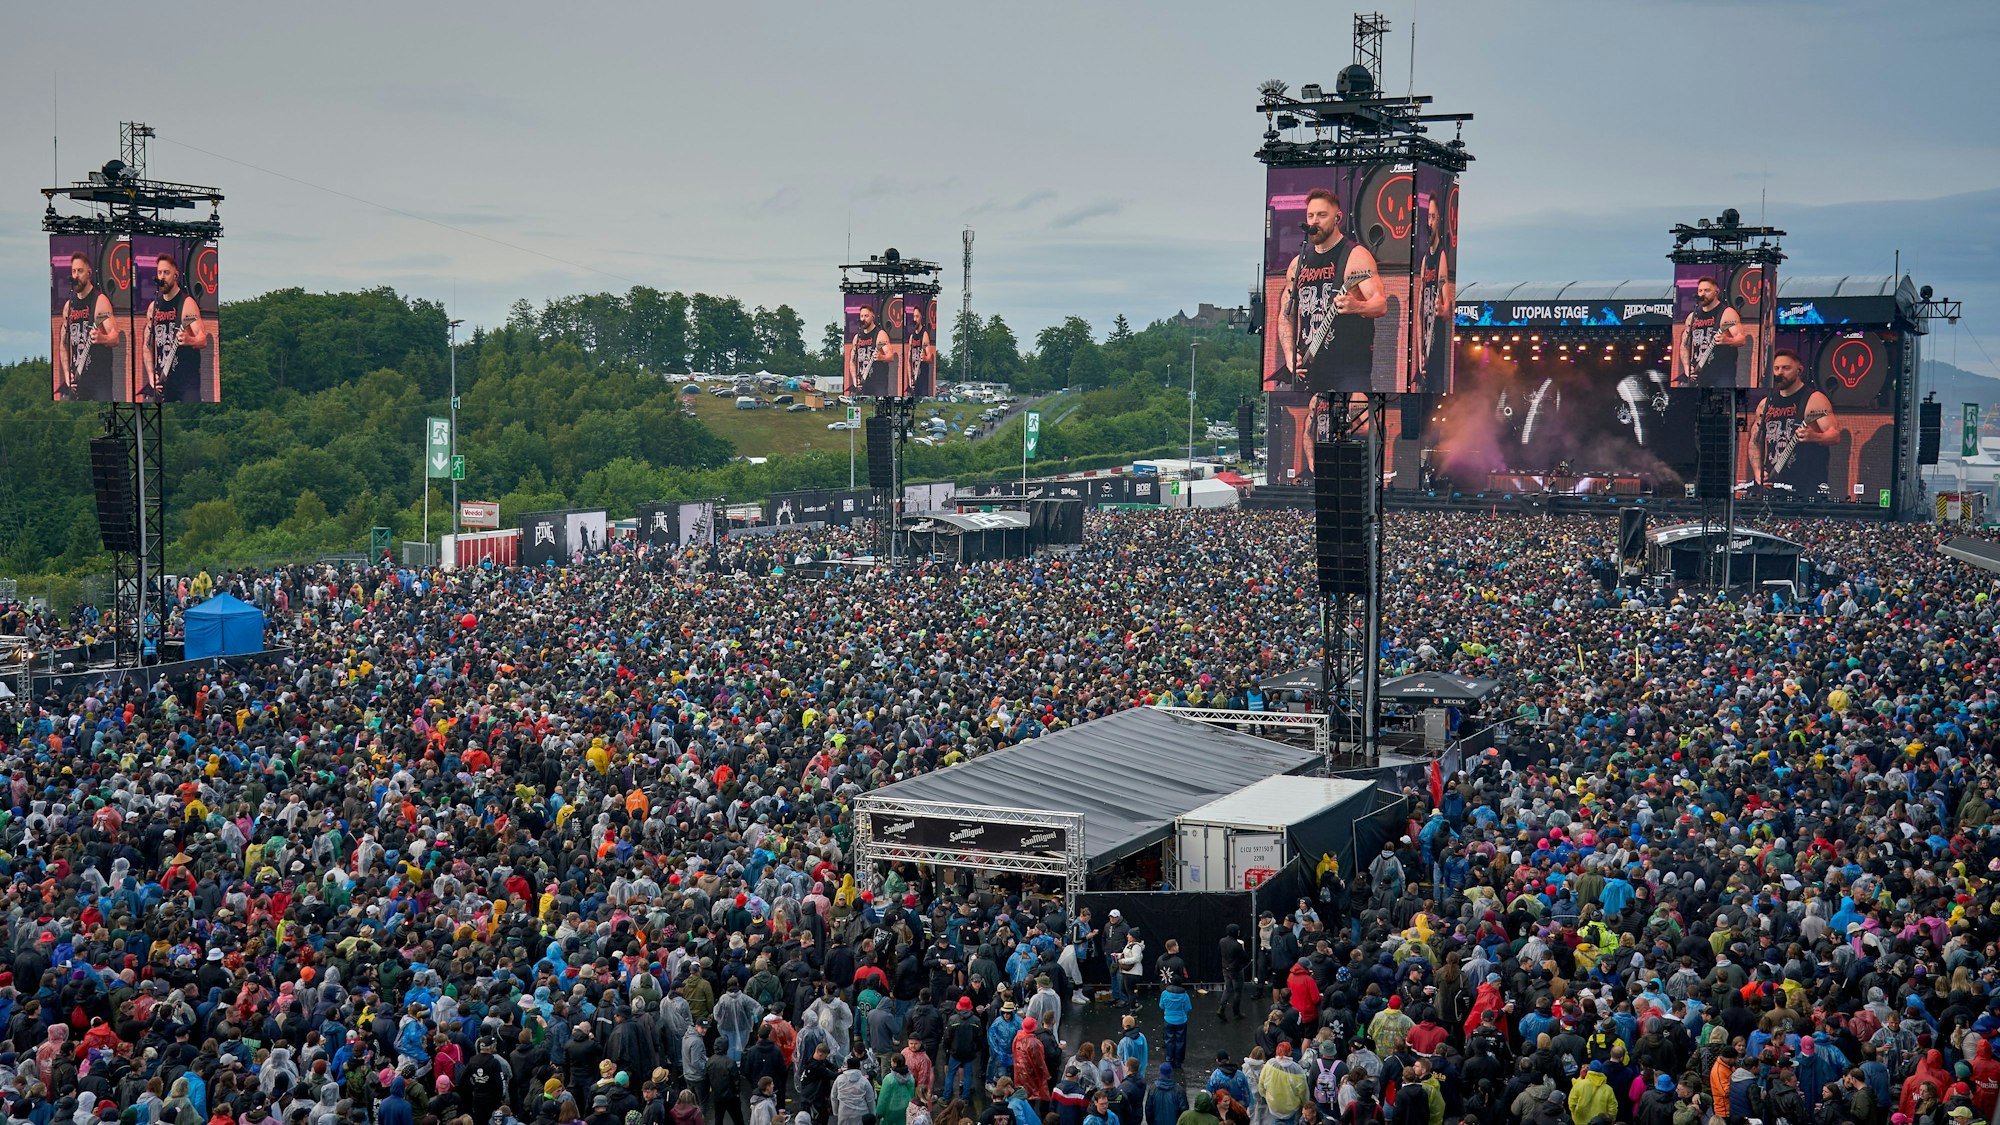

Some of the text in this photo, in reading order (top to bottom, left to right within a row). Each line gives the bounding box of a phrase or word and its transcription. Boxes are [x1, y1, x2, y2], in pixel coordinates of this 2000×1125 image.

[1458, 306, 1479, 320] RING
[1512, 306, 1589, 319] UTOPIA STAGE
[1623, 304, 1646, 320] ROCK
[535, 525, 556, 546] RING
[1975, 1079, 1999, 1089] Winston
